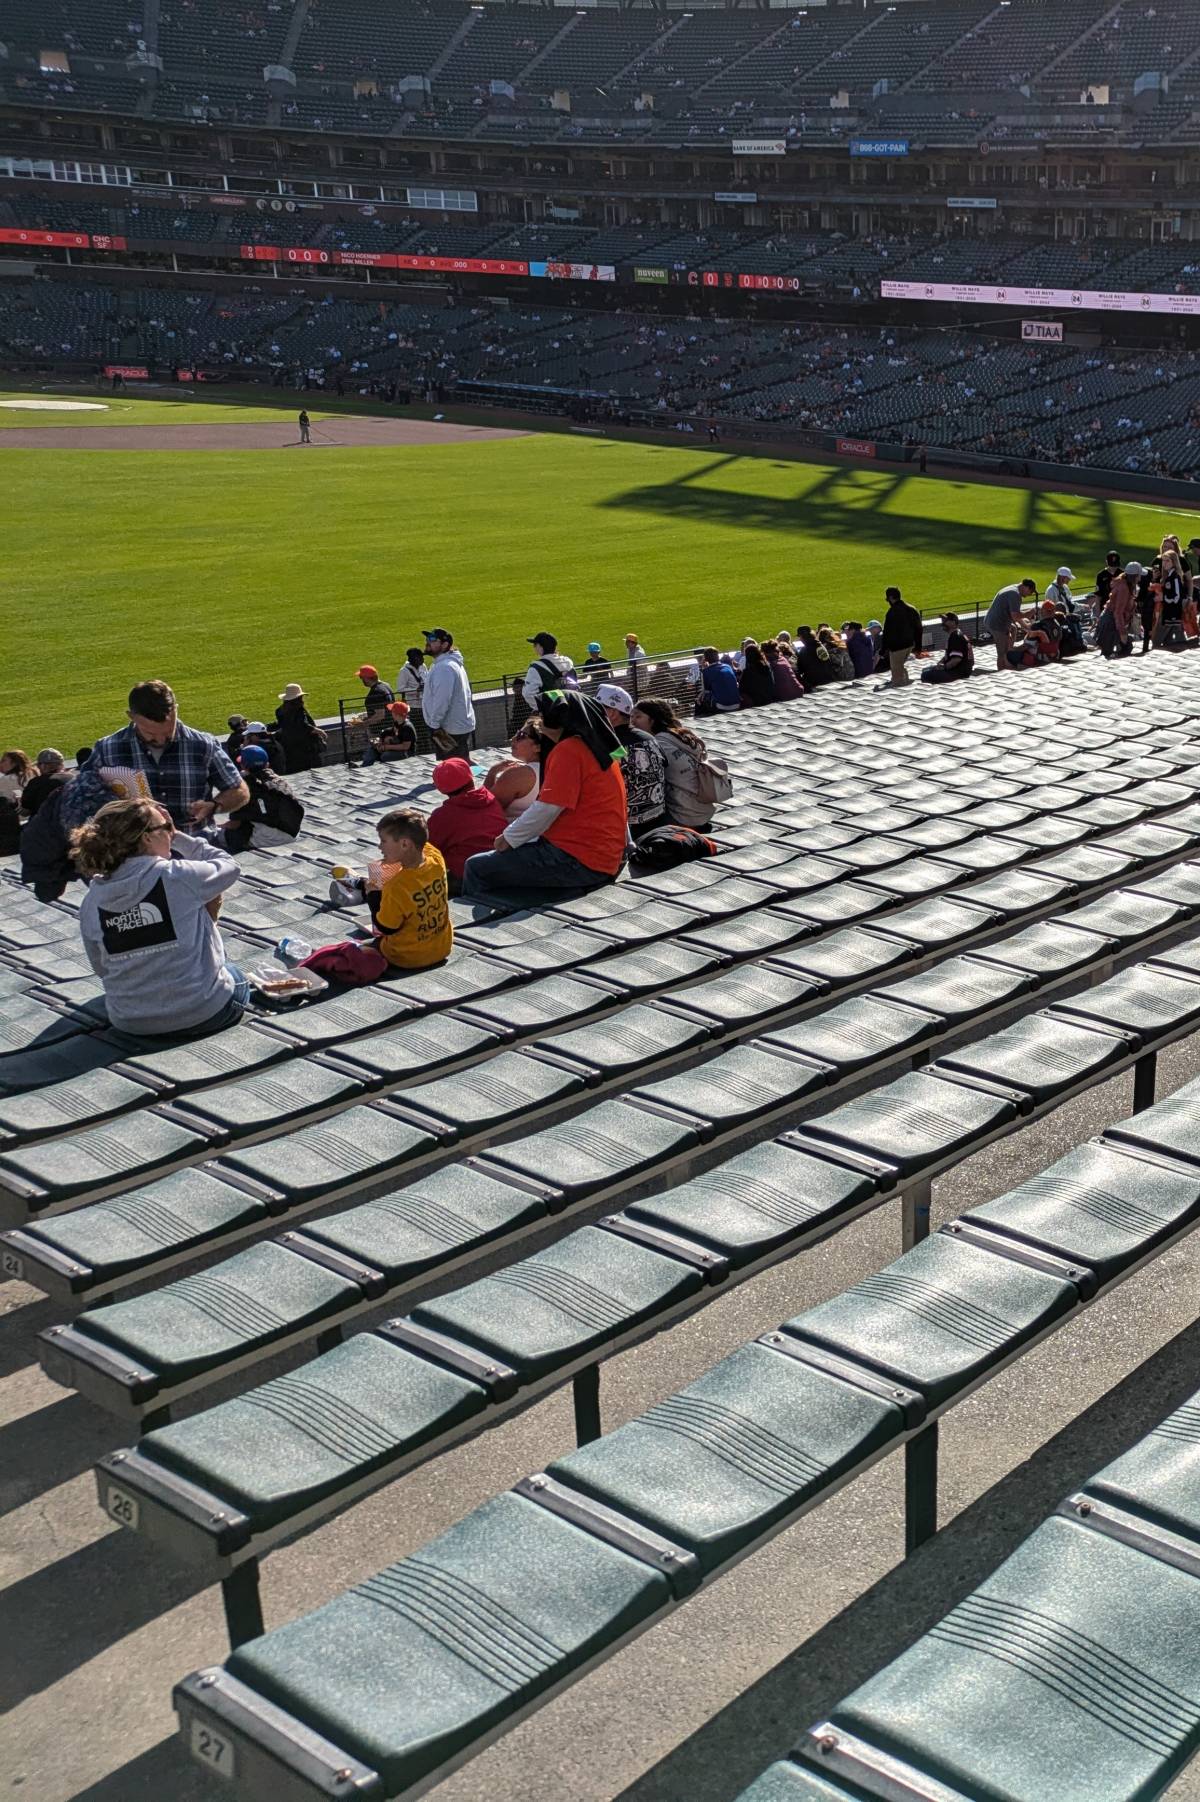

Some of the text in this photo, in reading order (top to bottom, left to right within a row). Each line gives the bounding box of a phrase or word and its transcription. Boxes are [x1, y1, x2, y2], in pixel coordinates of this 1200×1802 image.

[638, 269, 664, 278] nuveen
[1036, 326, 1060, 338] TIAA
[105, 909, 140, 928] NORTH
[117, 919, 143, 932] FACE
[6, 1257, 18, 1273] 24
[113, 1494, 132, 1522] 26
[199, 1731, 225, 1762] 27
